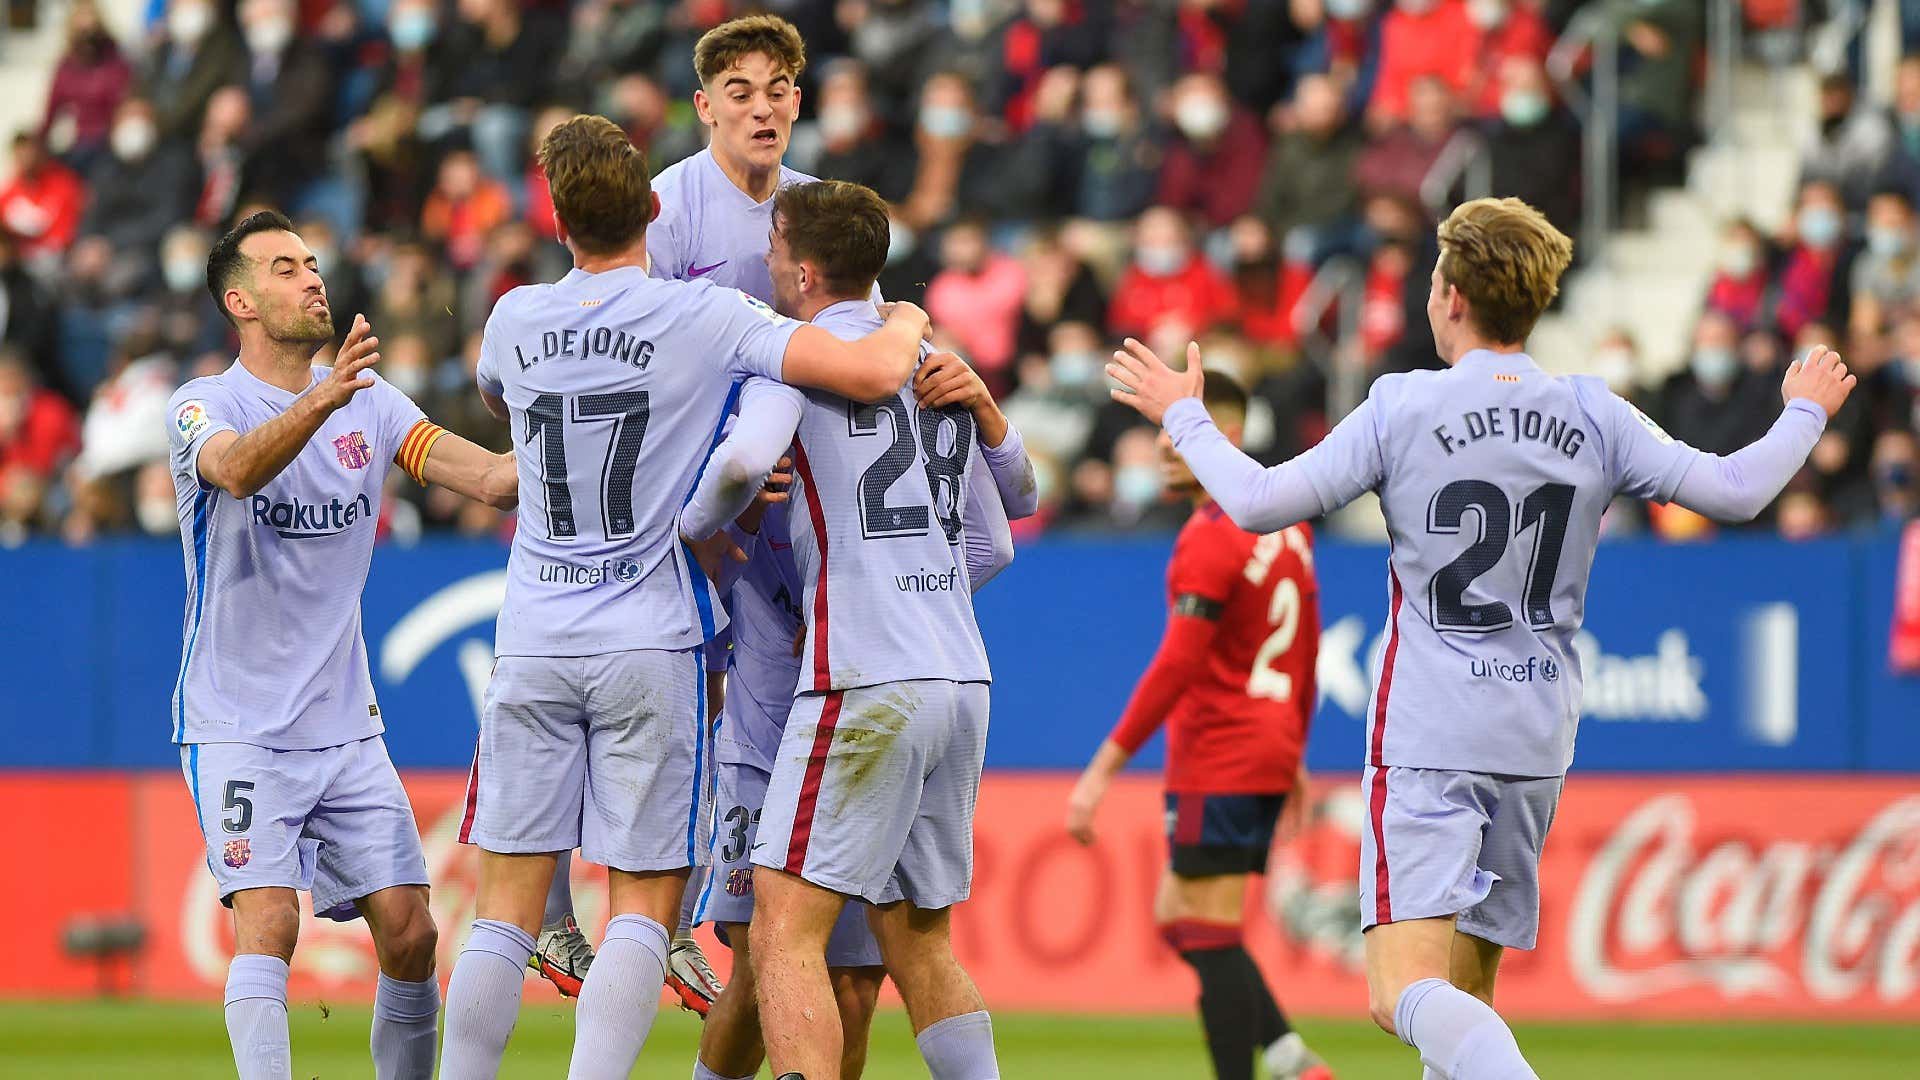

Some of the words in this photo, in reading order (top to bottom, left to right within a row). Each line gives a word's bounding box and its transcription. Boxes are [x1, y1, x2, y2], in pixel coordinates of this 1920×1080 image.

[580, 326, 655, 371] JONG
[1510, 407, 1586, 461] JONG
[525, 390, 650, 542] 17
[848, 394, 976, 546] 28
[252, 492, 371, 531] Rakuten
[539, 559, 611, 586] unicef
[895, 566, 957, 592] unicef
[1427, 479, 1577, 632] 21
[1246, 577, 1301, 704] 2
[221, 779, 256, 834] 5
[721, 805, 762, 863] 3
